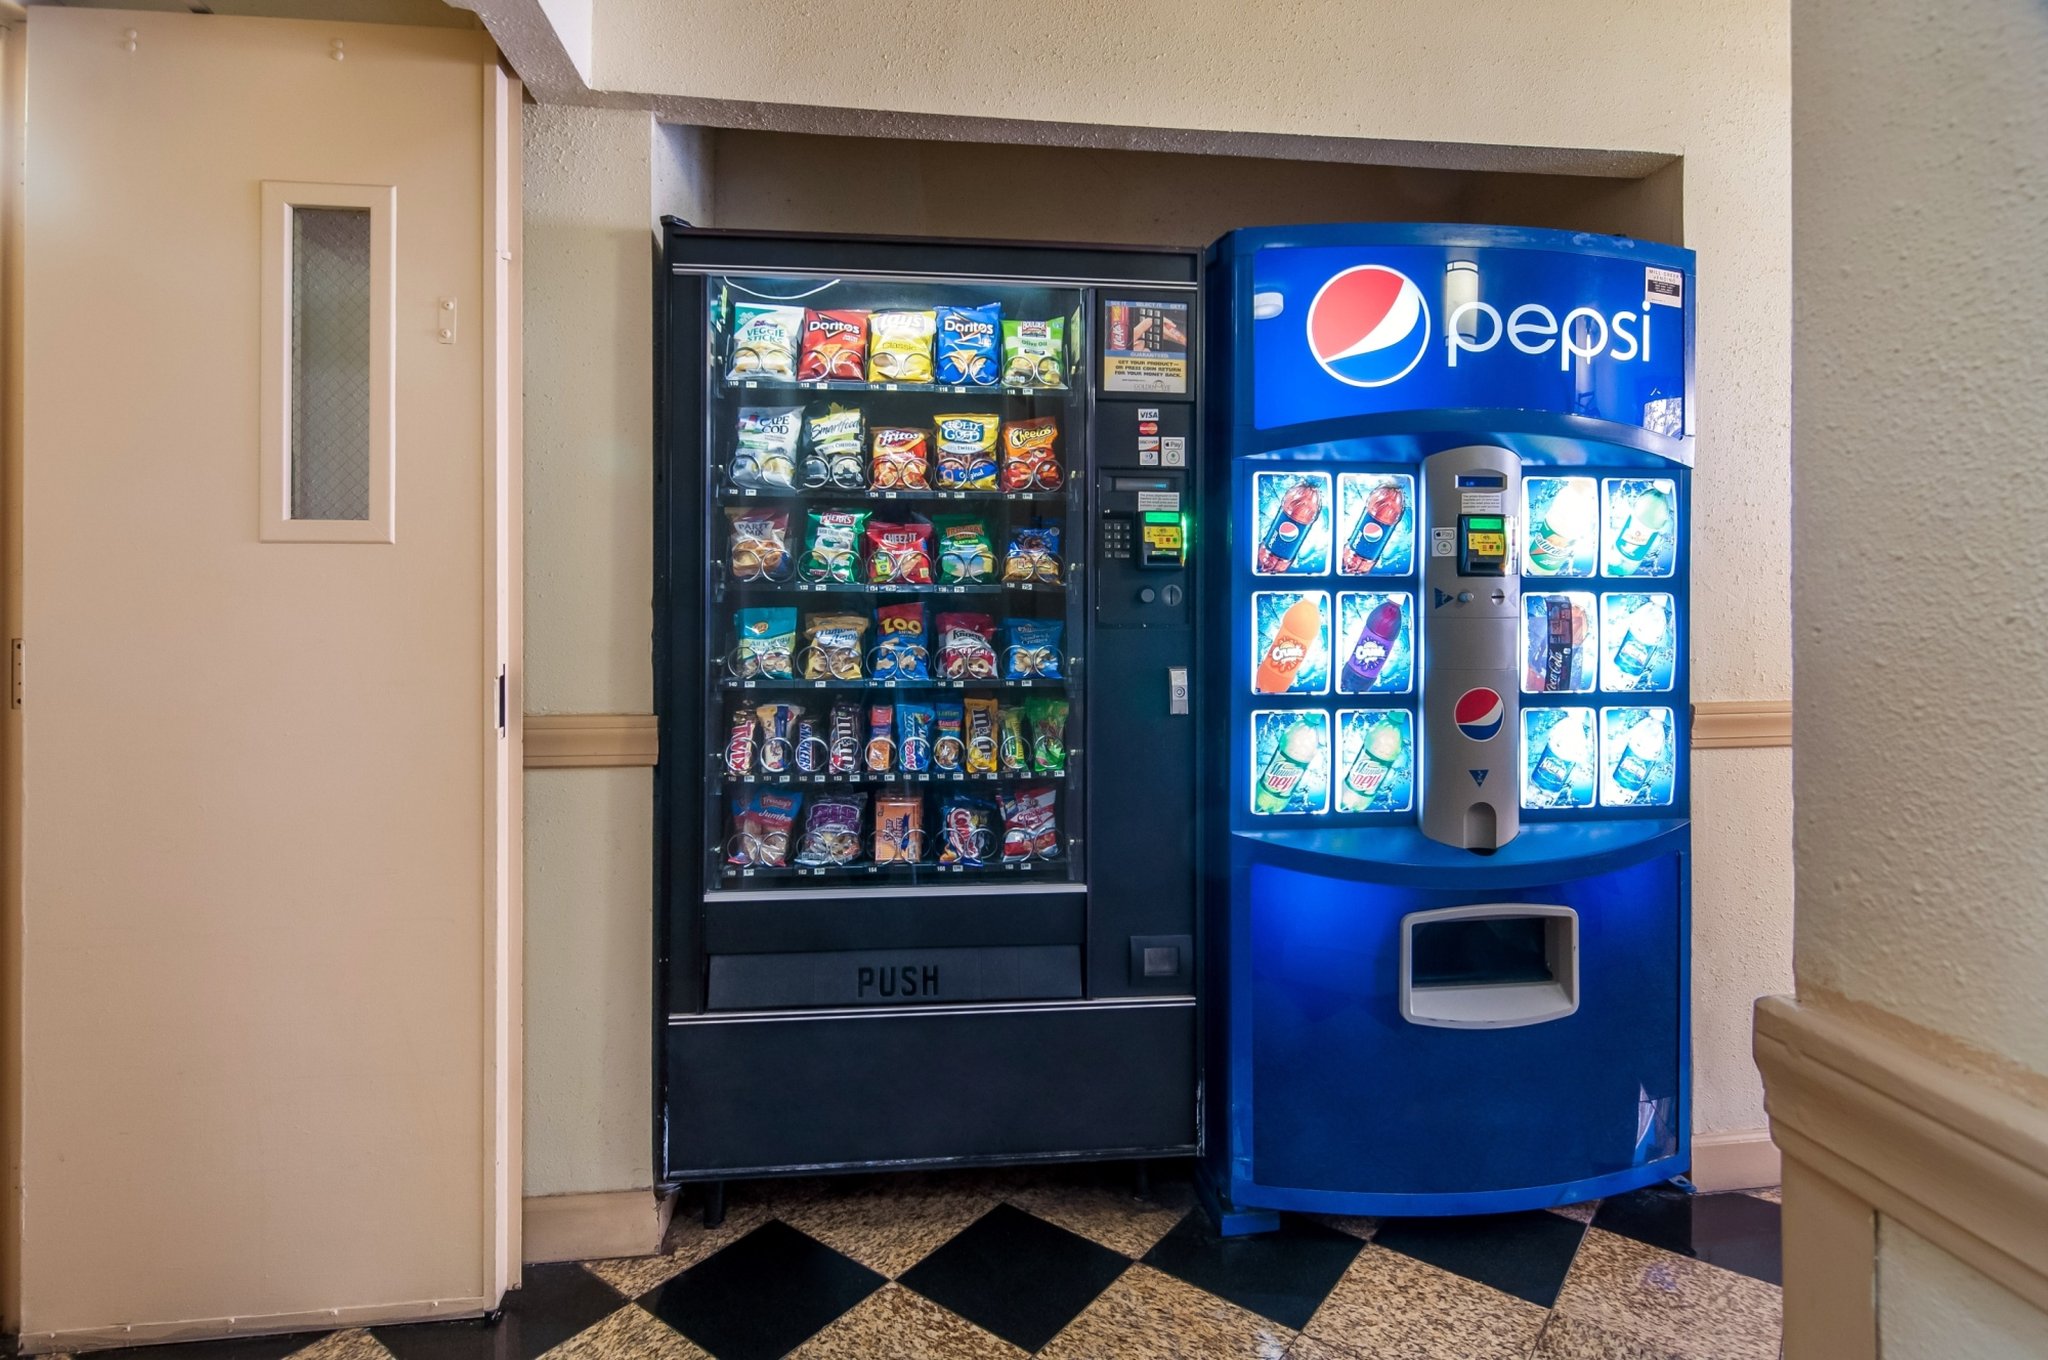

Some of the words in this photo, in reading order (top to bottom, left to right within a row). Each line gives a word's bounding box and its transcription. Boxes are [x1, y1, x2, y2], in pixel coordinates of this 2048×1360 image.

[747, 327, 785, 337] VEGGIE
[809, 320, 860, 335] Doritos
[944, 319, 994, 335] Doritos
[1448, 301, 1651, 371] pepsi
[760, 415, 790, 426] CAPE
[1140, 411, 1159, 419] VISA
[761, 425, 789, 435] COD
[1011, 425, 1053, 447] Cheetos
[959, 468, 984, 481] Oginal
[880, 617, 922, 634] ZOO
[800, 722, 813, 771] SNICKERS
[758, 809, 793, 822] Jumbo
[858, 965, 939, 998] PUSH
